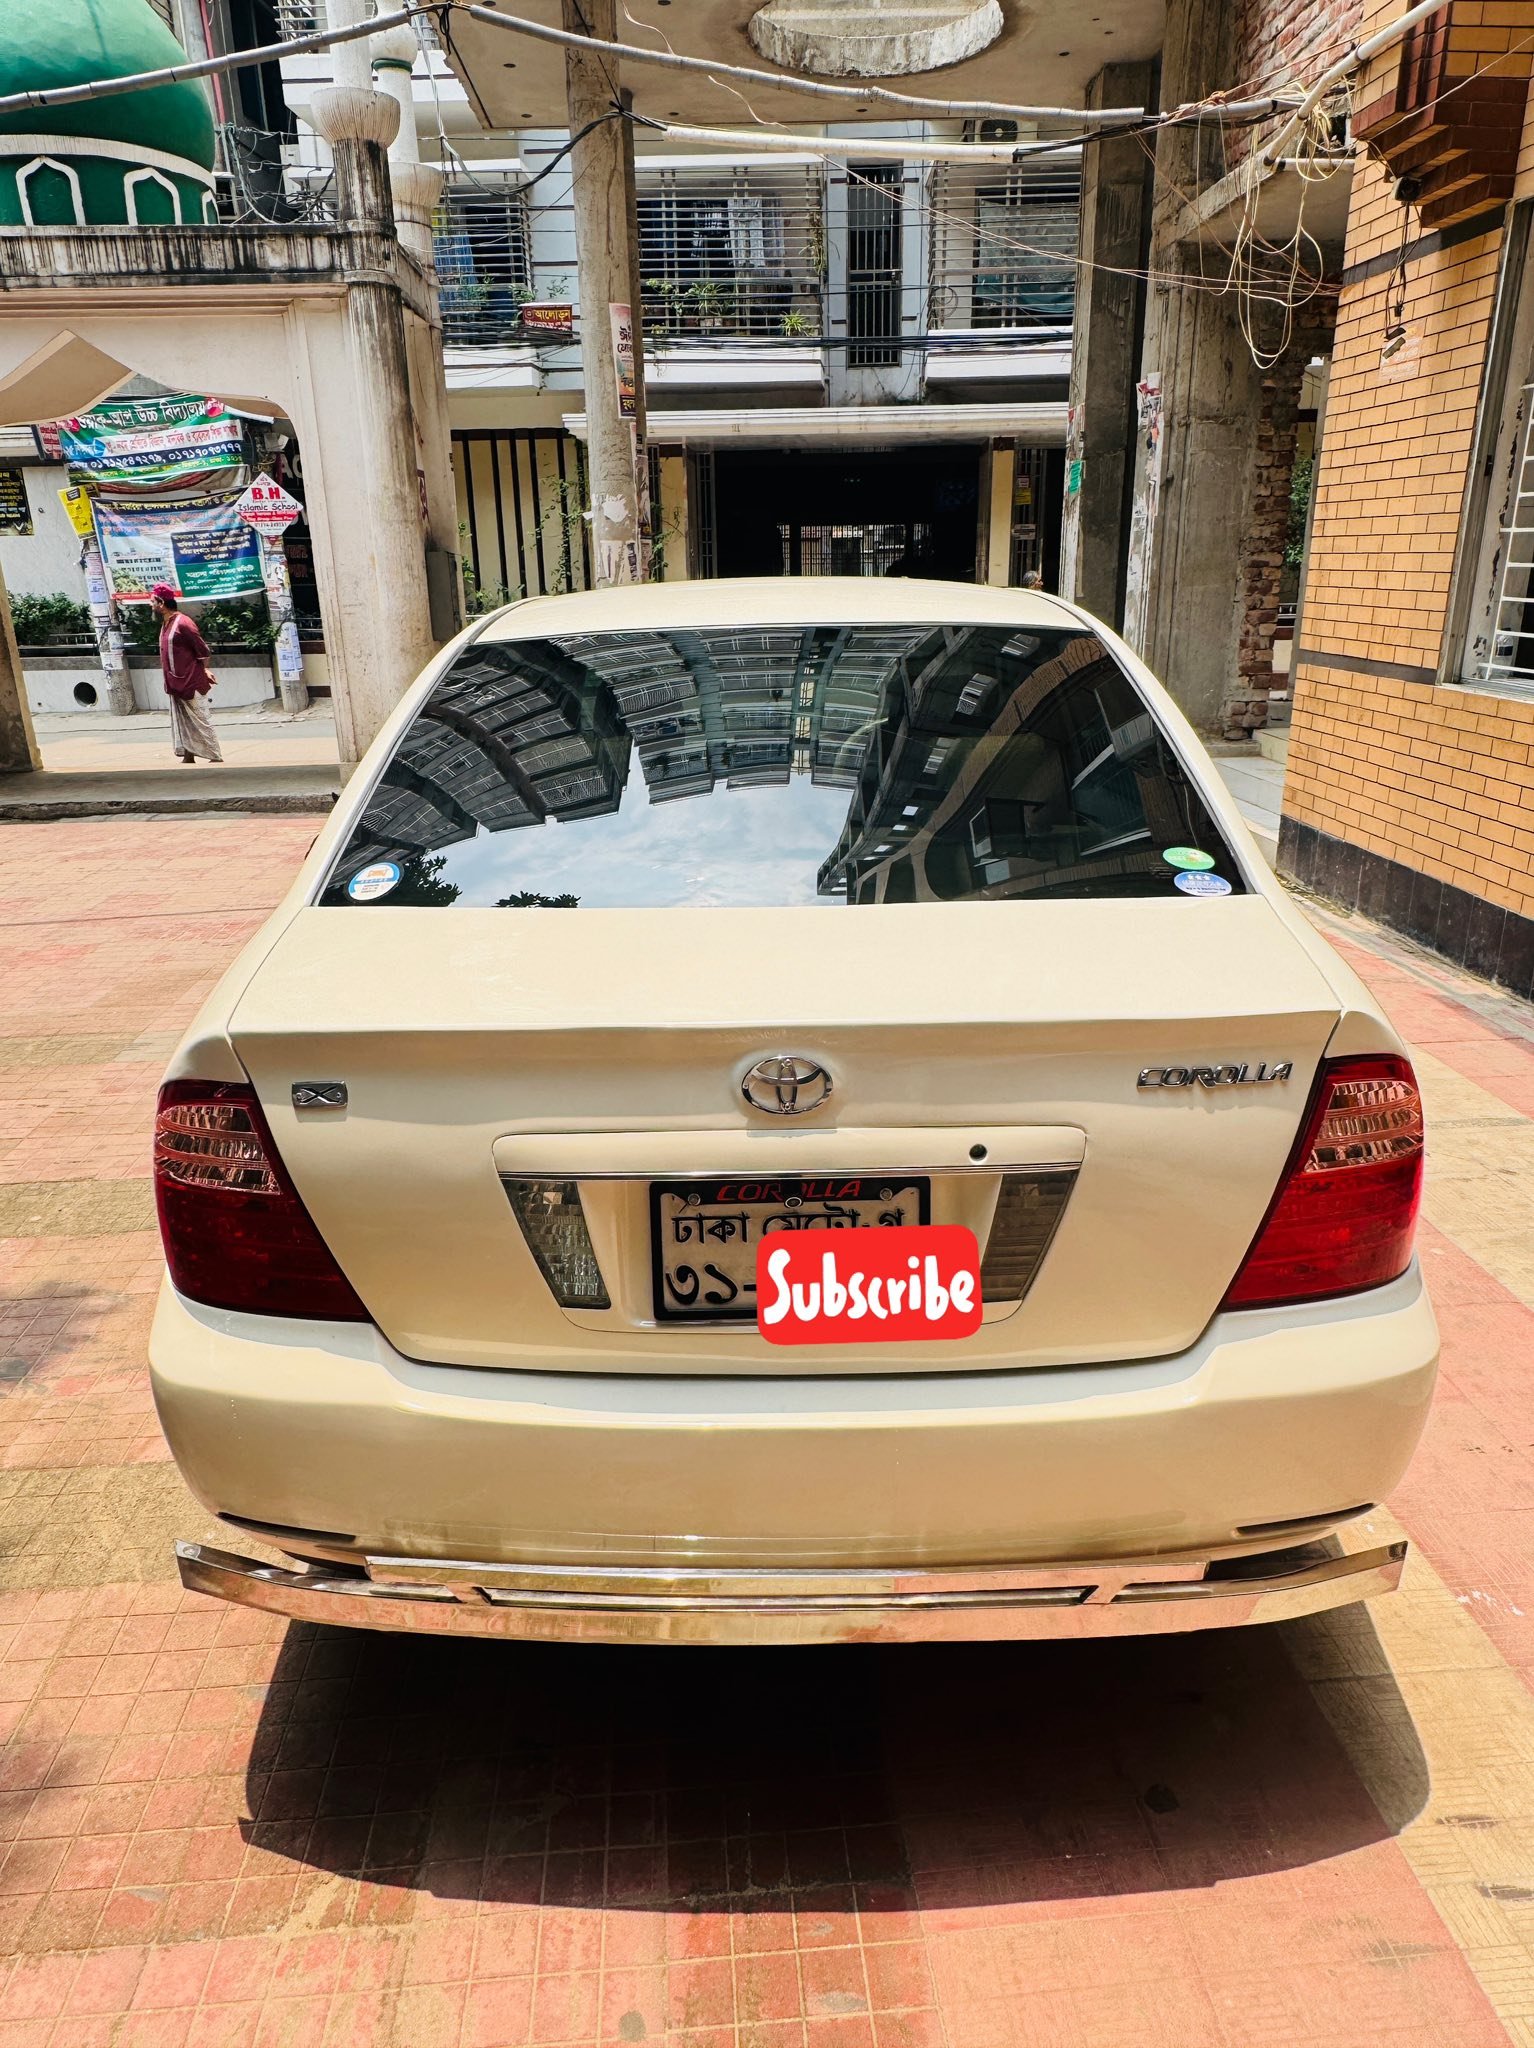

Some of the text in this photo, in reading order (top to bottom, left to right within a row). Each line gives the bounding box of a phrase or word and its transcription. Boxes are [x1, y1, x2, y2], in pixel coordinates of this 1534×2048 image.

[135, 404, 158, 422] উচ্চ
[160, 399, 206, 421] বিদ্যালয়
[251, 487, 286, 500] B.H.
[238, 503, 268, 512] Islamic
[272, 502, 298, 511] School
[1137, 1062, 1293, 1088] COROLLA
[716, 1180, 861, 1202] CORLLA
[671, 1211, 750, 1244] ঢাকা
